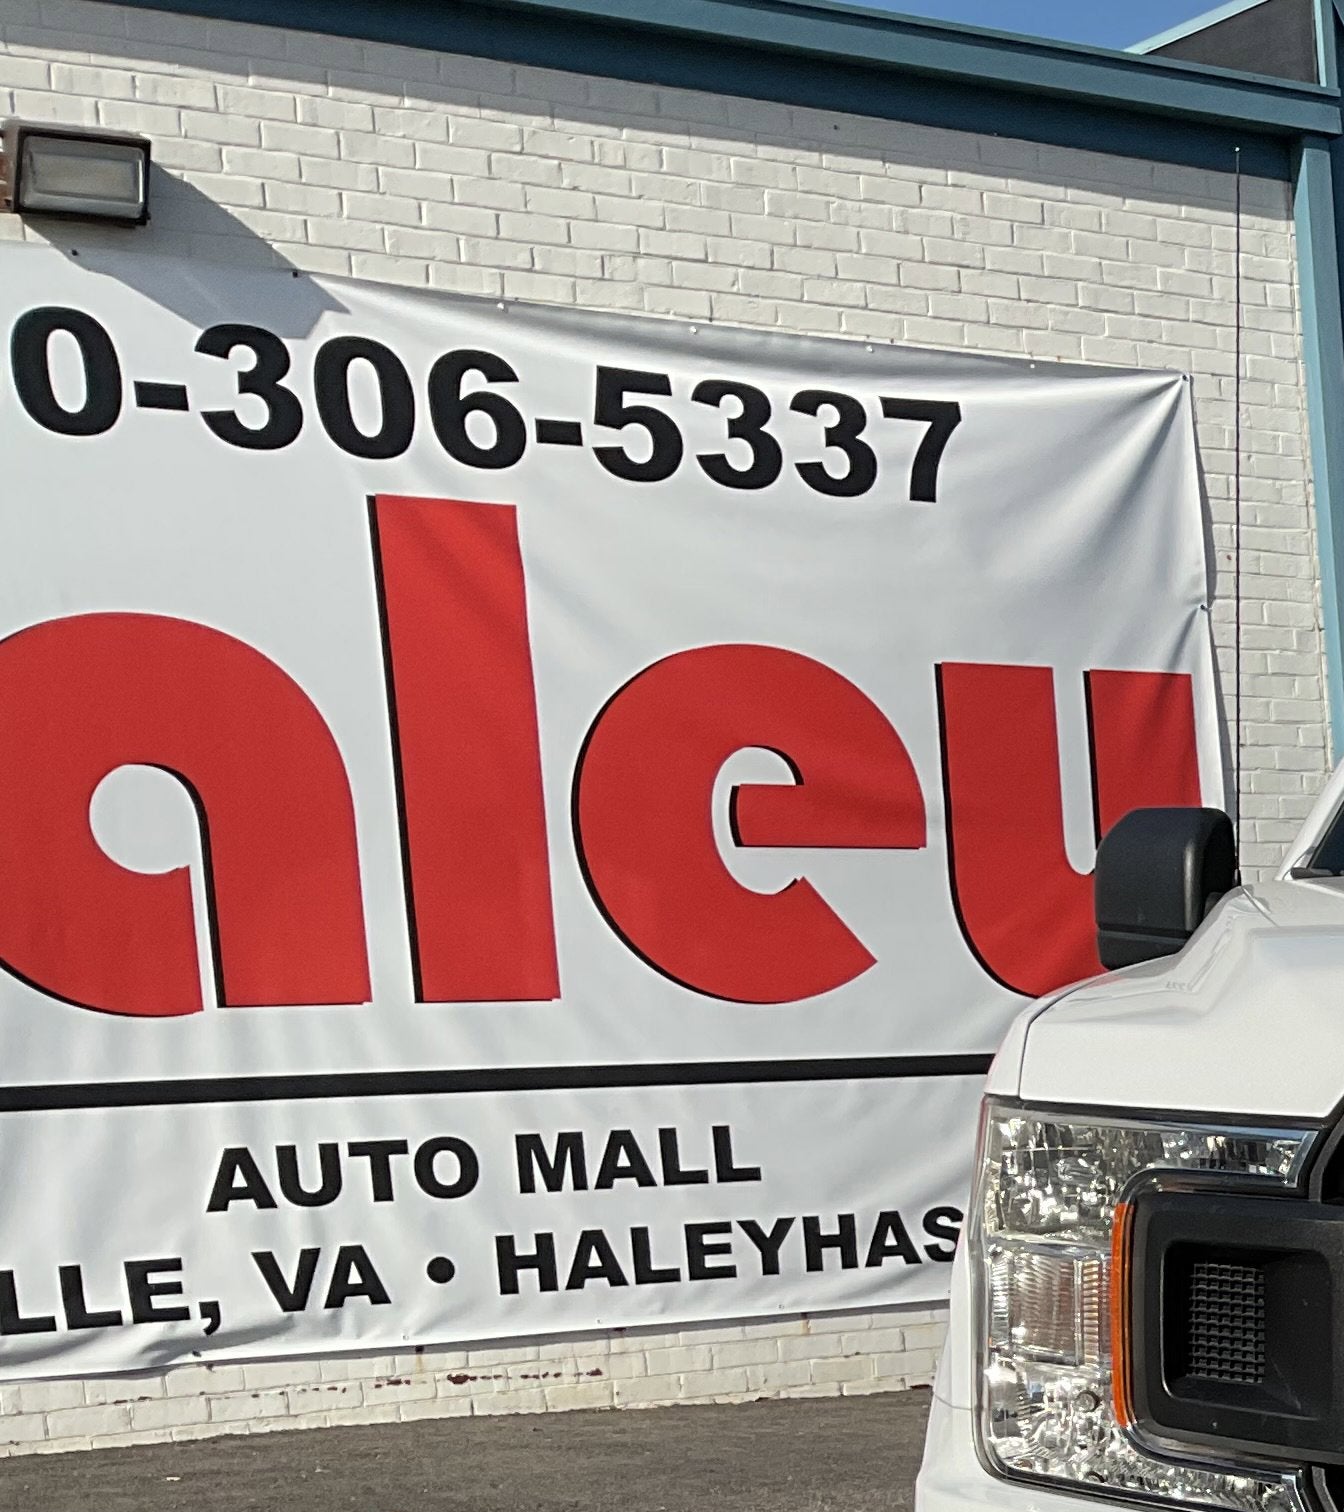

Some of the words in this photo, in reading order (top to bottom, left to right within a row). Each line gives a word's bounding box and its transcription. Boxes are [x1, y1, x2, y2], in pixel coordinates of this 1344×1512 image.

[10, 305, 963, 504] 0-306-5337
[206, 1135, 479, 1213] AUTO
[517, 1124, 762, 1194] MALL
[0, 1257, 221, 1336] LLE,
[250, 1245, 391, 1312] VA
[495, 1206, 964, 1295] HALEYHAS
